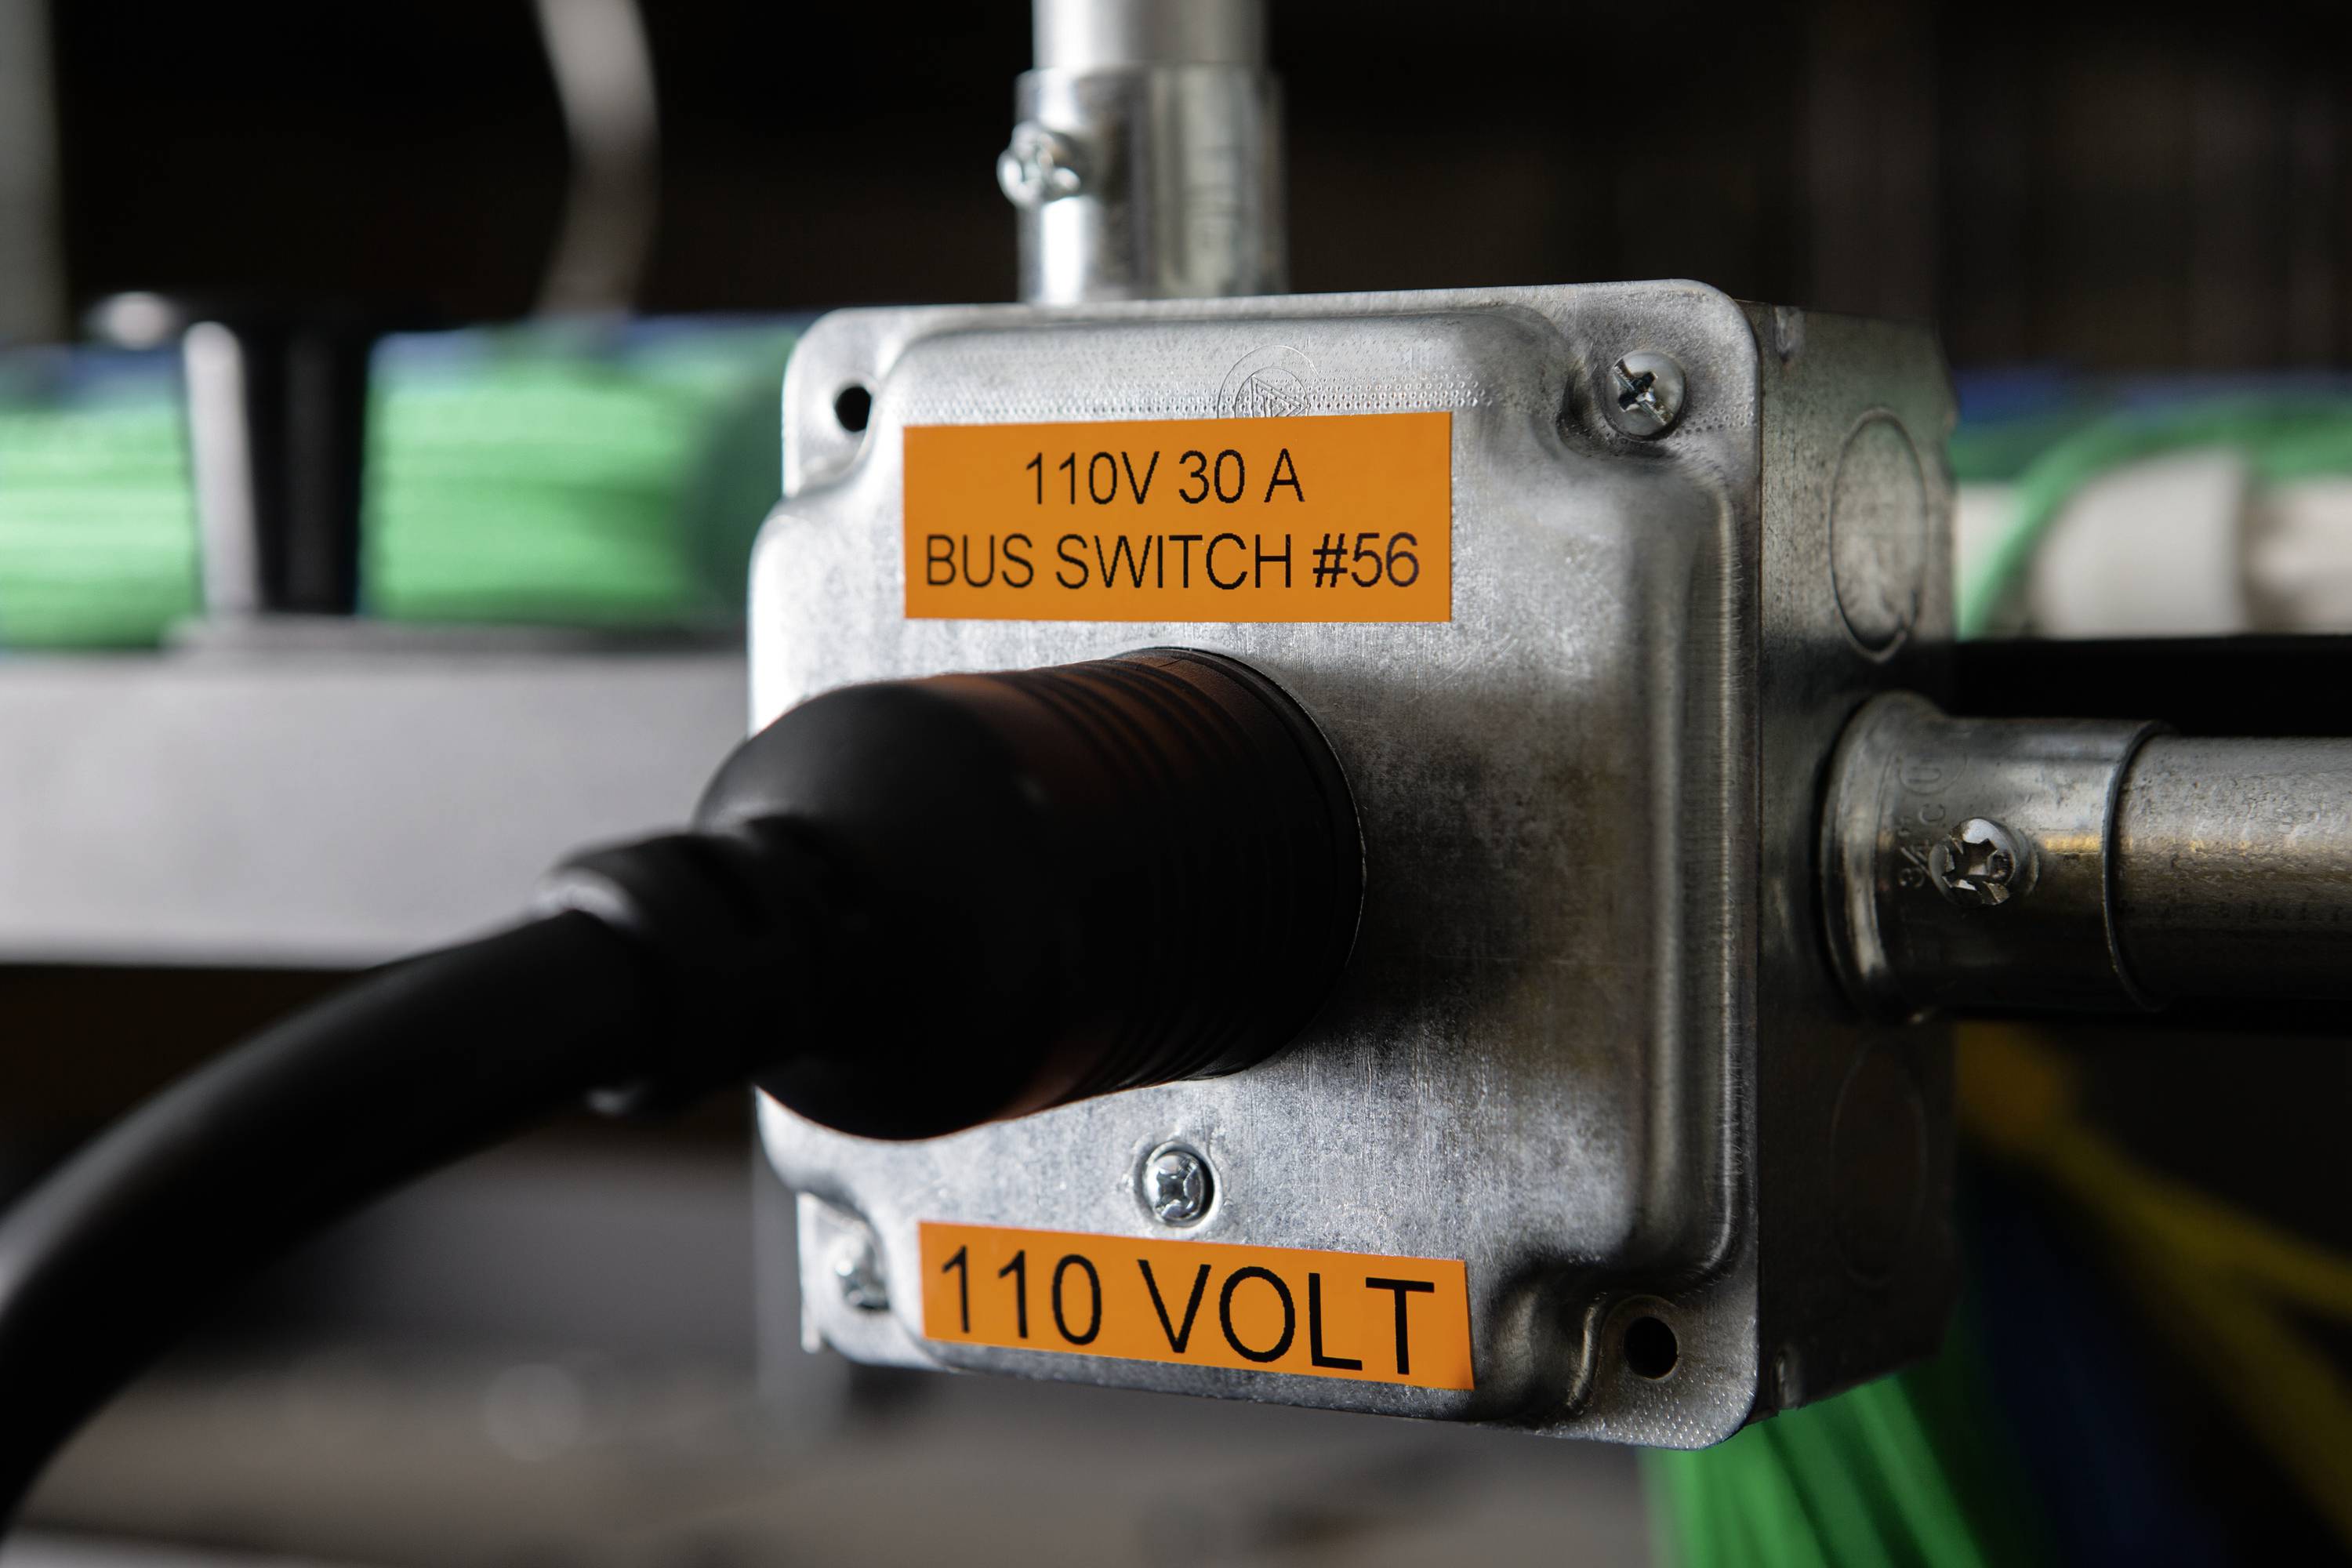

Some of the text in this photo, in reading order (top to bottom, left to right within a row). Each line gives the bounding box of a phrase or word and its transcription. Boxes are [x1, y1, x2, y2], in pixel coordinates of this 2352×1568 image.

[1026, 448, 1305, 505] 110V 30 A
[927, 532, 1419, 590] BUS SWITCH #56
[942, 1245, 1435, 1375] 110 VOLT
